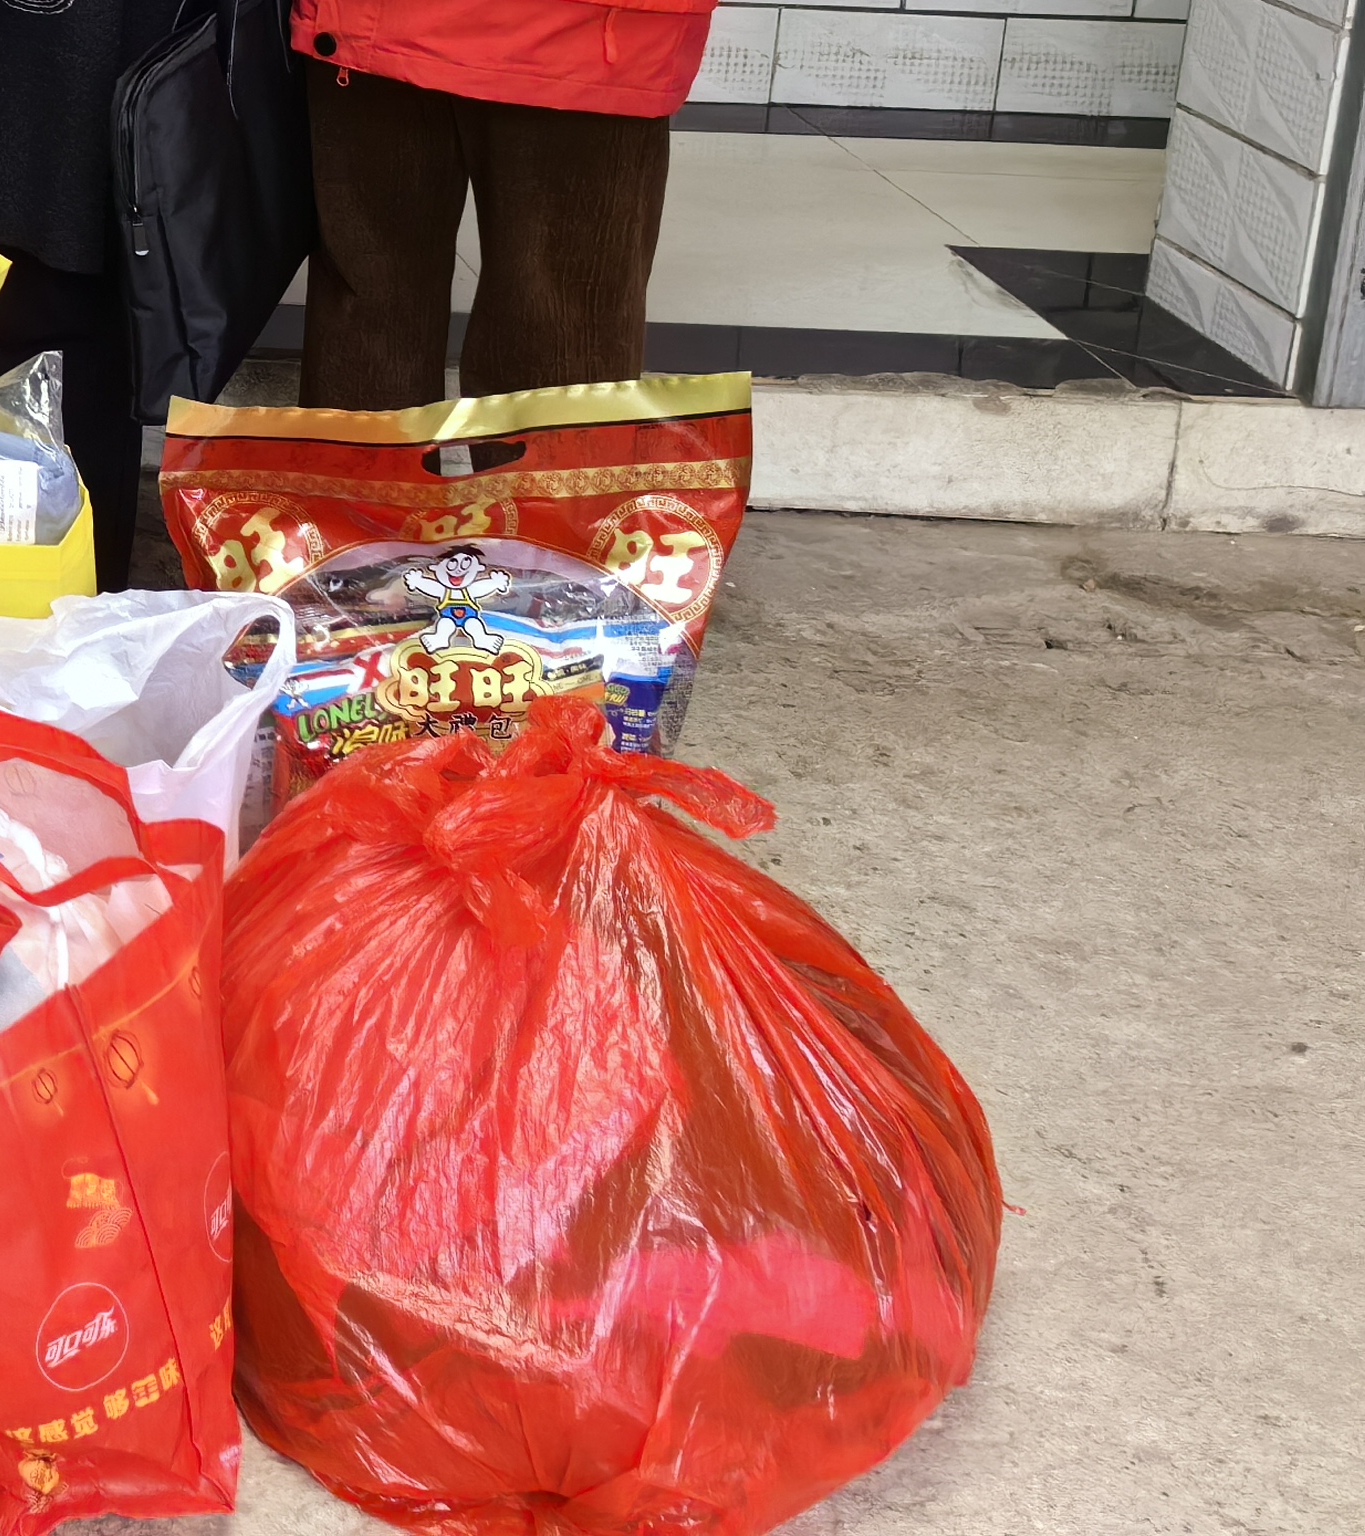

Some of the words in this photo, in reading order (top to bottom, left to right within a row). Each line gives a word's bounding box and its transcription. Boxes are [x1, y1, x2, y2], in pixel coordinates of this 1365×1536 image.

[205, 507, 305, 595] 旺
[606, 527, 705, 606] 旺
[298, 691, 387, 743] LONEL
[398, 659, 534, 713] 旺旺
[44, 1305, 118, 1368] 可口可乐
